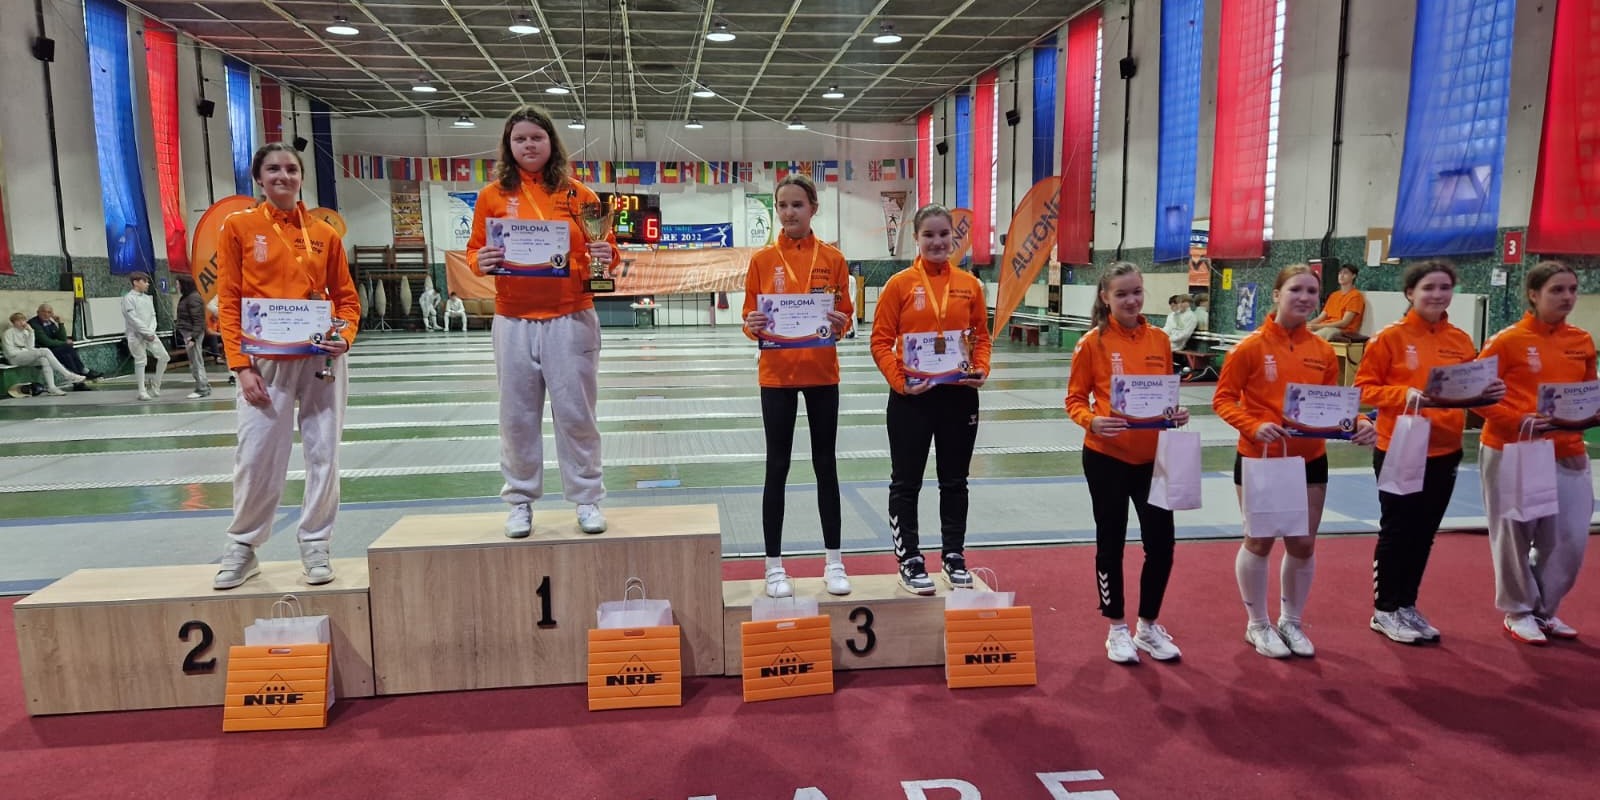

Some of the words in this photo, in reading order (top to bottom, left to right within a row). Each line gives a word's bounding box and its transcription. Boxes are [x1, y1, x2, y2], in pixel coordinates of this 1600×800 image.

[646, 218, 658, 238] 6
[1508, 239, 1517, 256] 3
[536, 576, 557, 628] 1
[846, 606, 877, 656] 3
[178, 620, 217, 675] 2
[965, 652, 1017, 665] NRF
[760, 662, 816, 678] NRF
[606, 673, 663, 687] NRF
[243, 693, 304, 707] NRF
